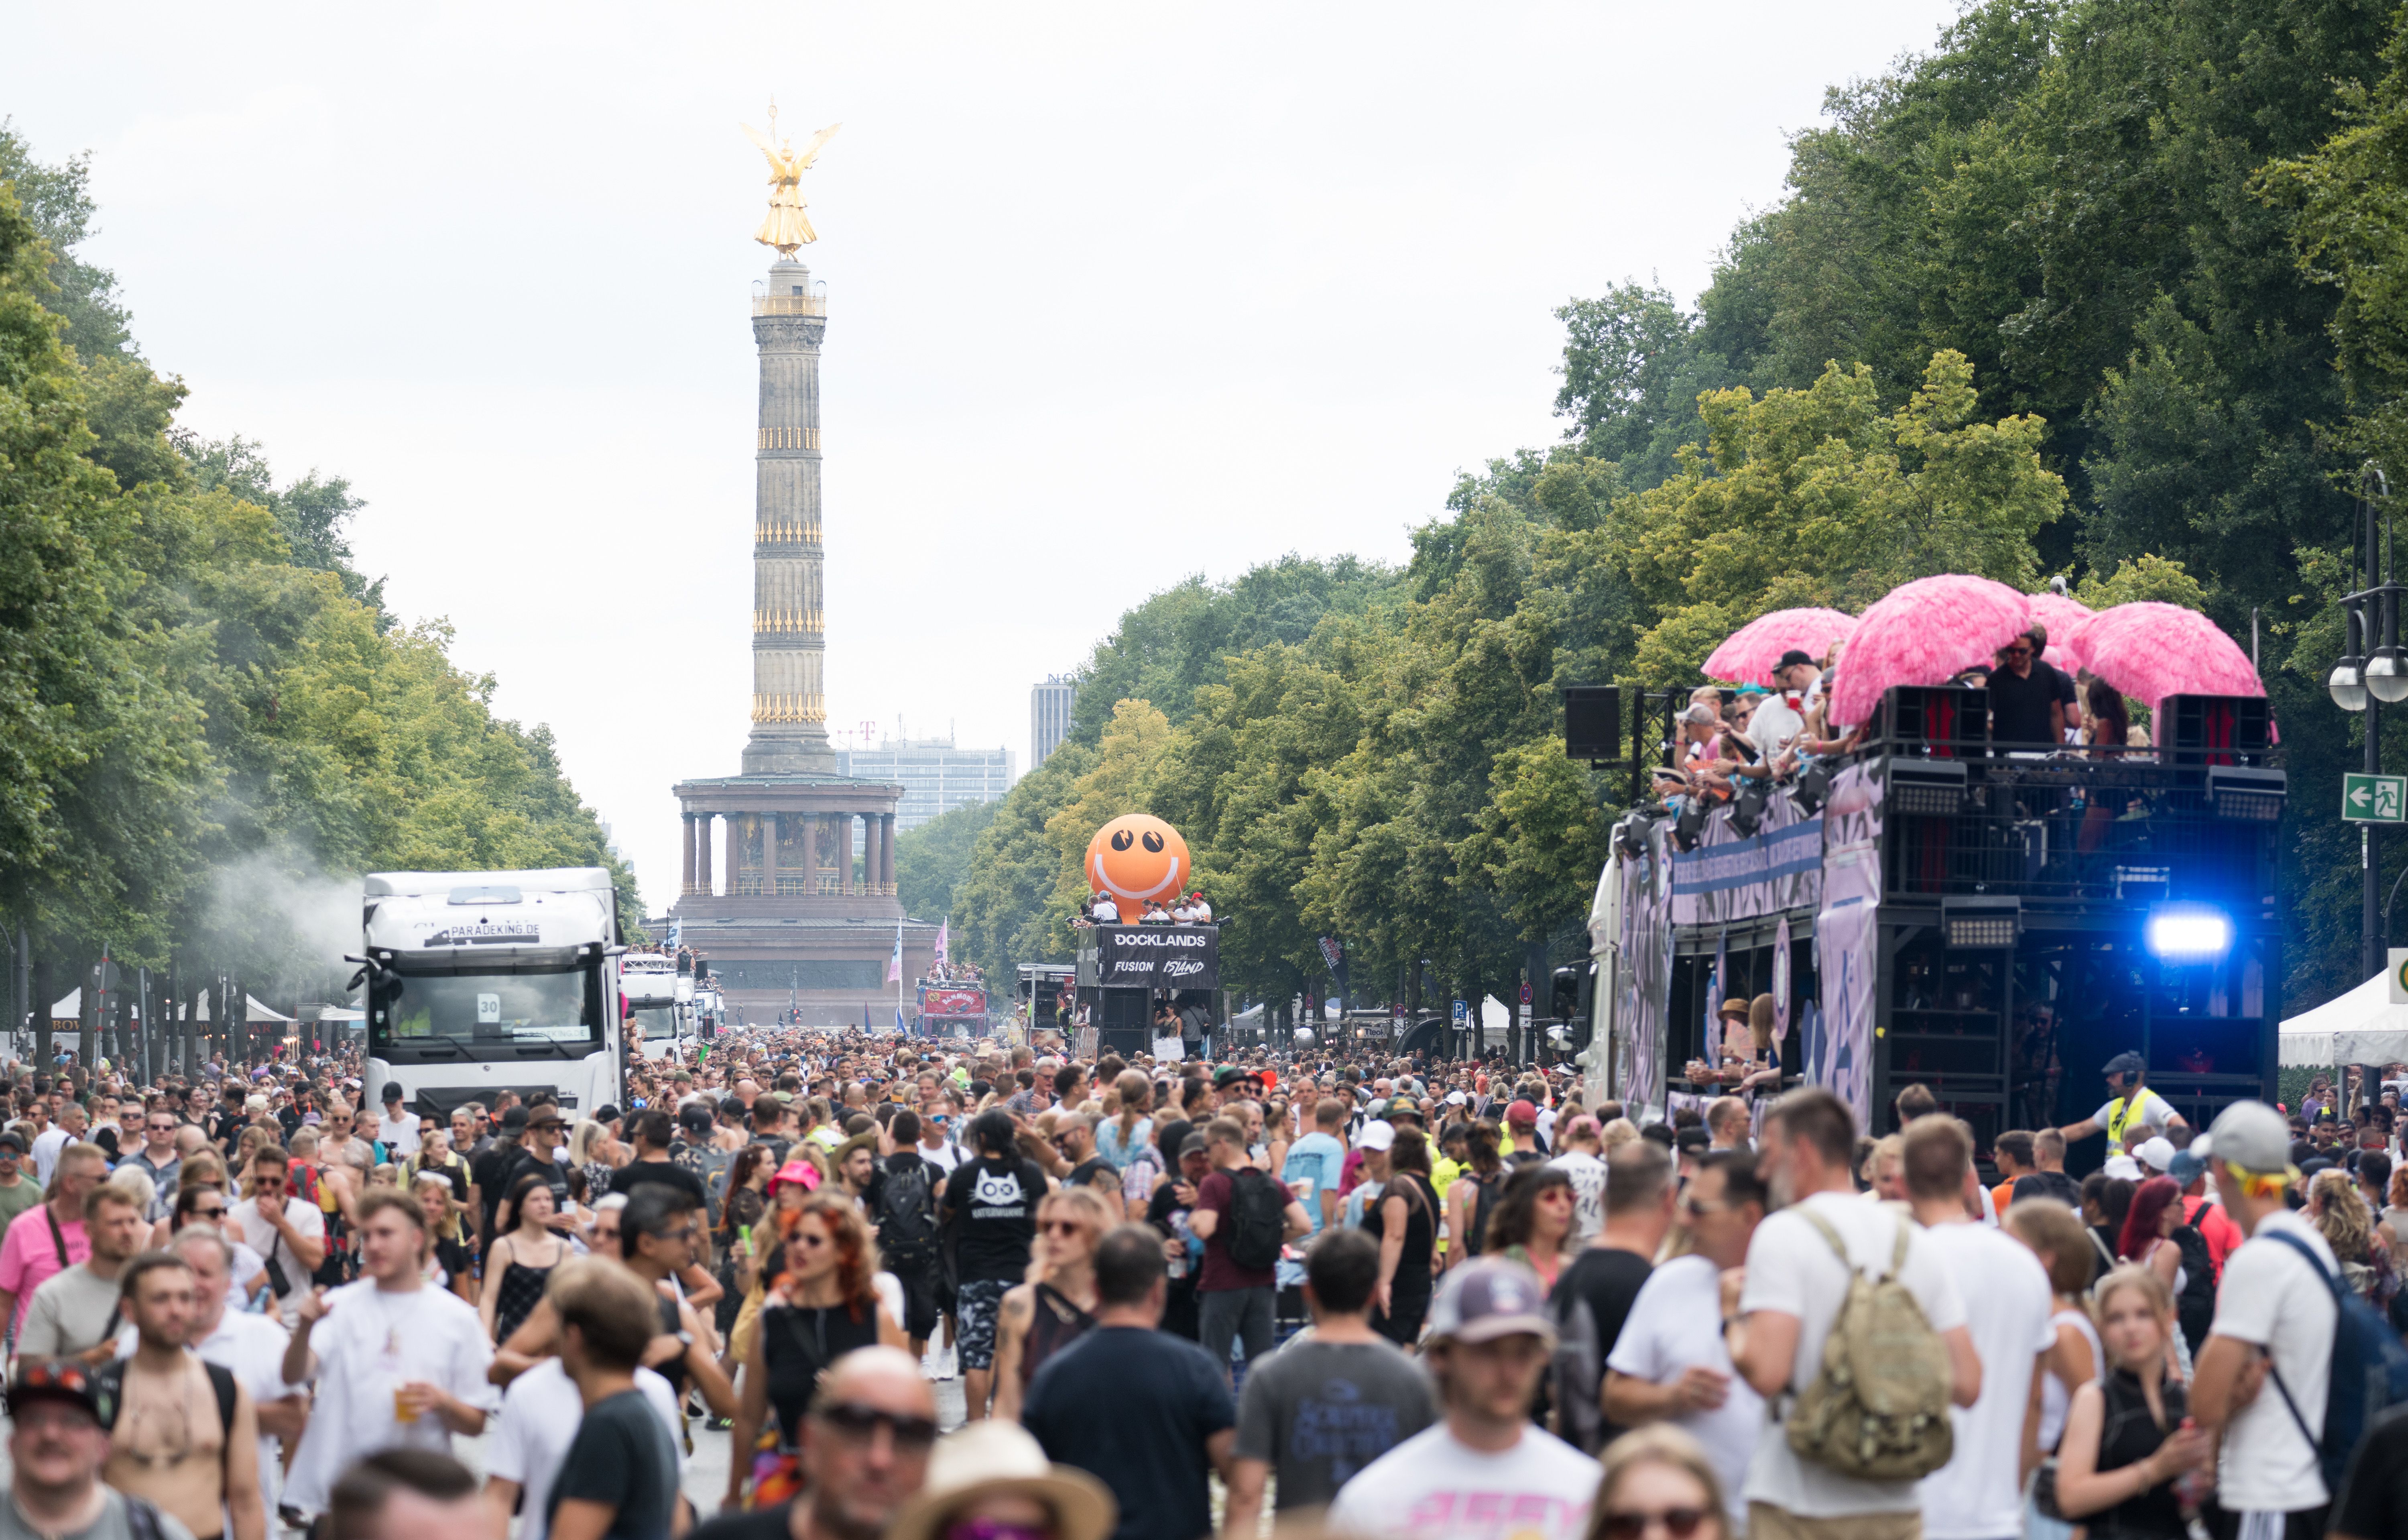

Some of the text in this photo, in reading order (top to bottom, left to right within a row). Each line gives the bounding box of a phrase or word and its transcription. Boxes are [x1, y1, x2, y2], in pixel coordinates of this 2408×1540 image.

[452, 924, 540, 937] PARADEKING.DE
[1115, 934, 1206, 947] DOCKLANDS
[1115, 961, 1155, 972] FUSION
[1163, 960, 1204, 977] ISLAND
[942, 992, 976, 1005] BAMMOBIL
[480, 1001, 498, 1013] 30
[1455, 1003, 1462, 1016] P
